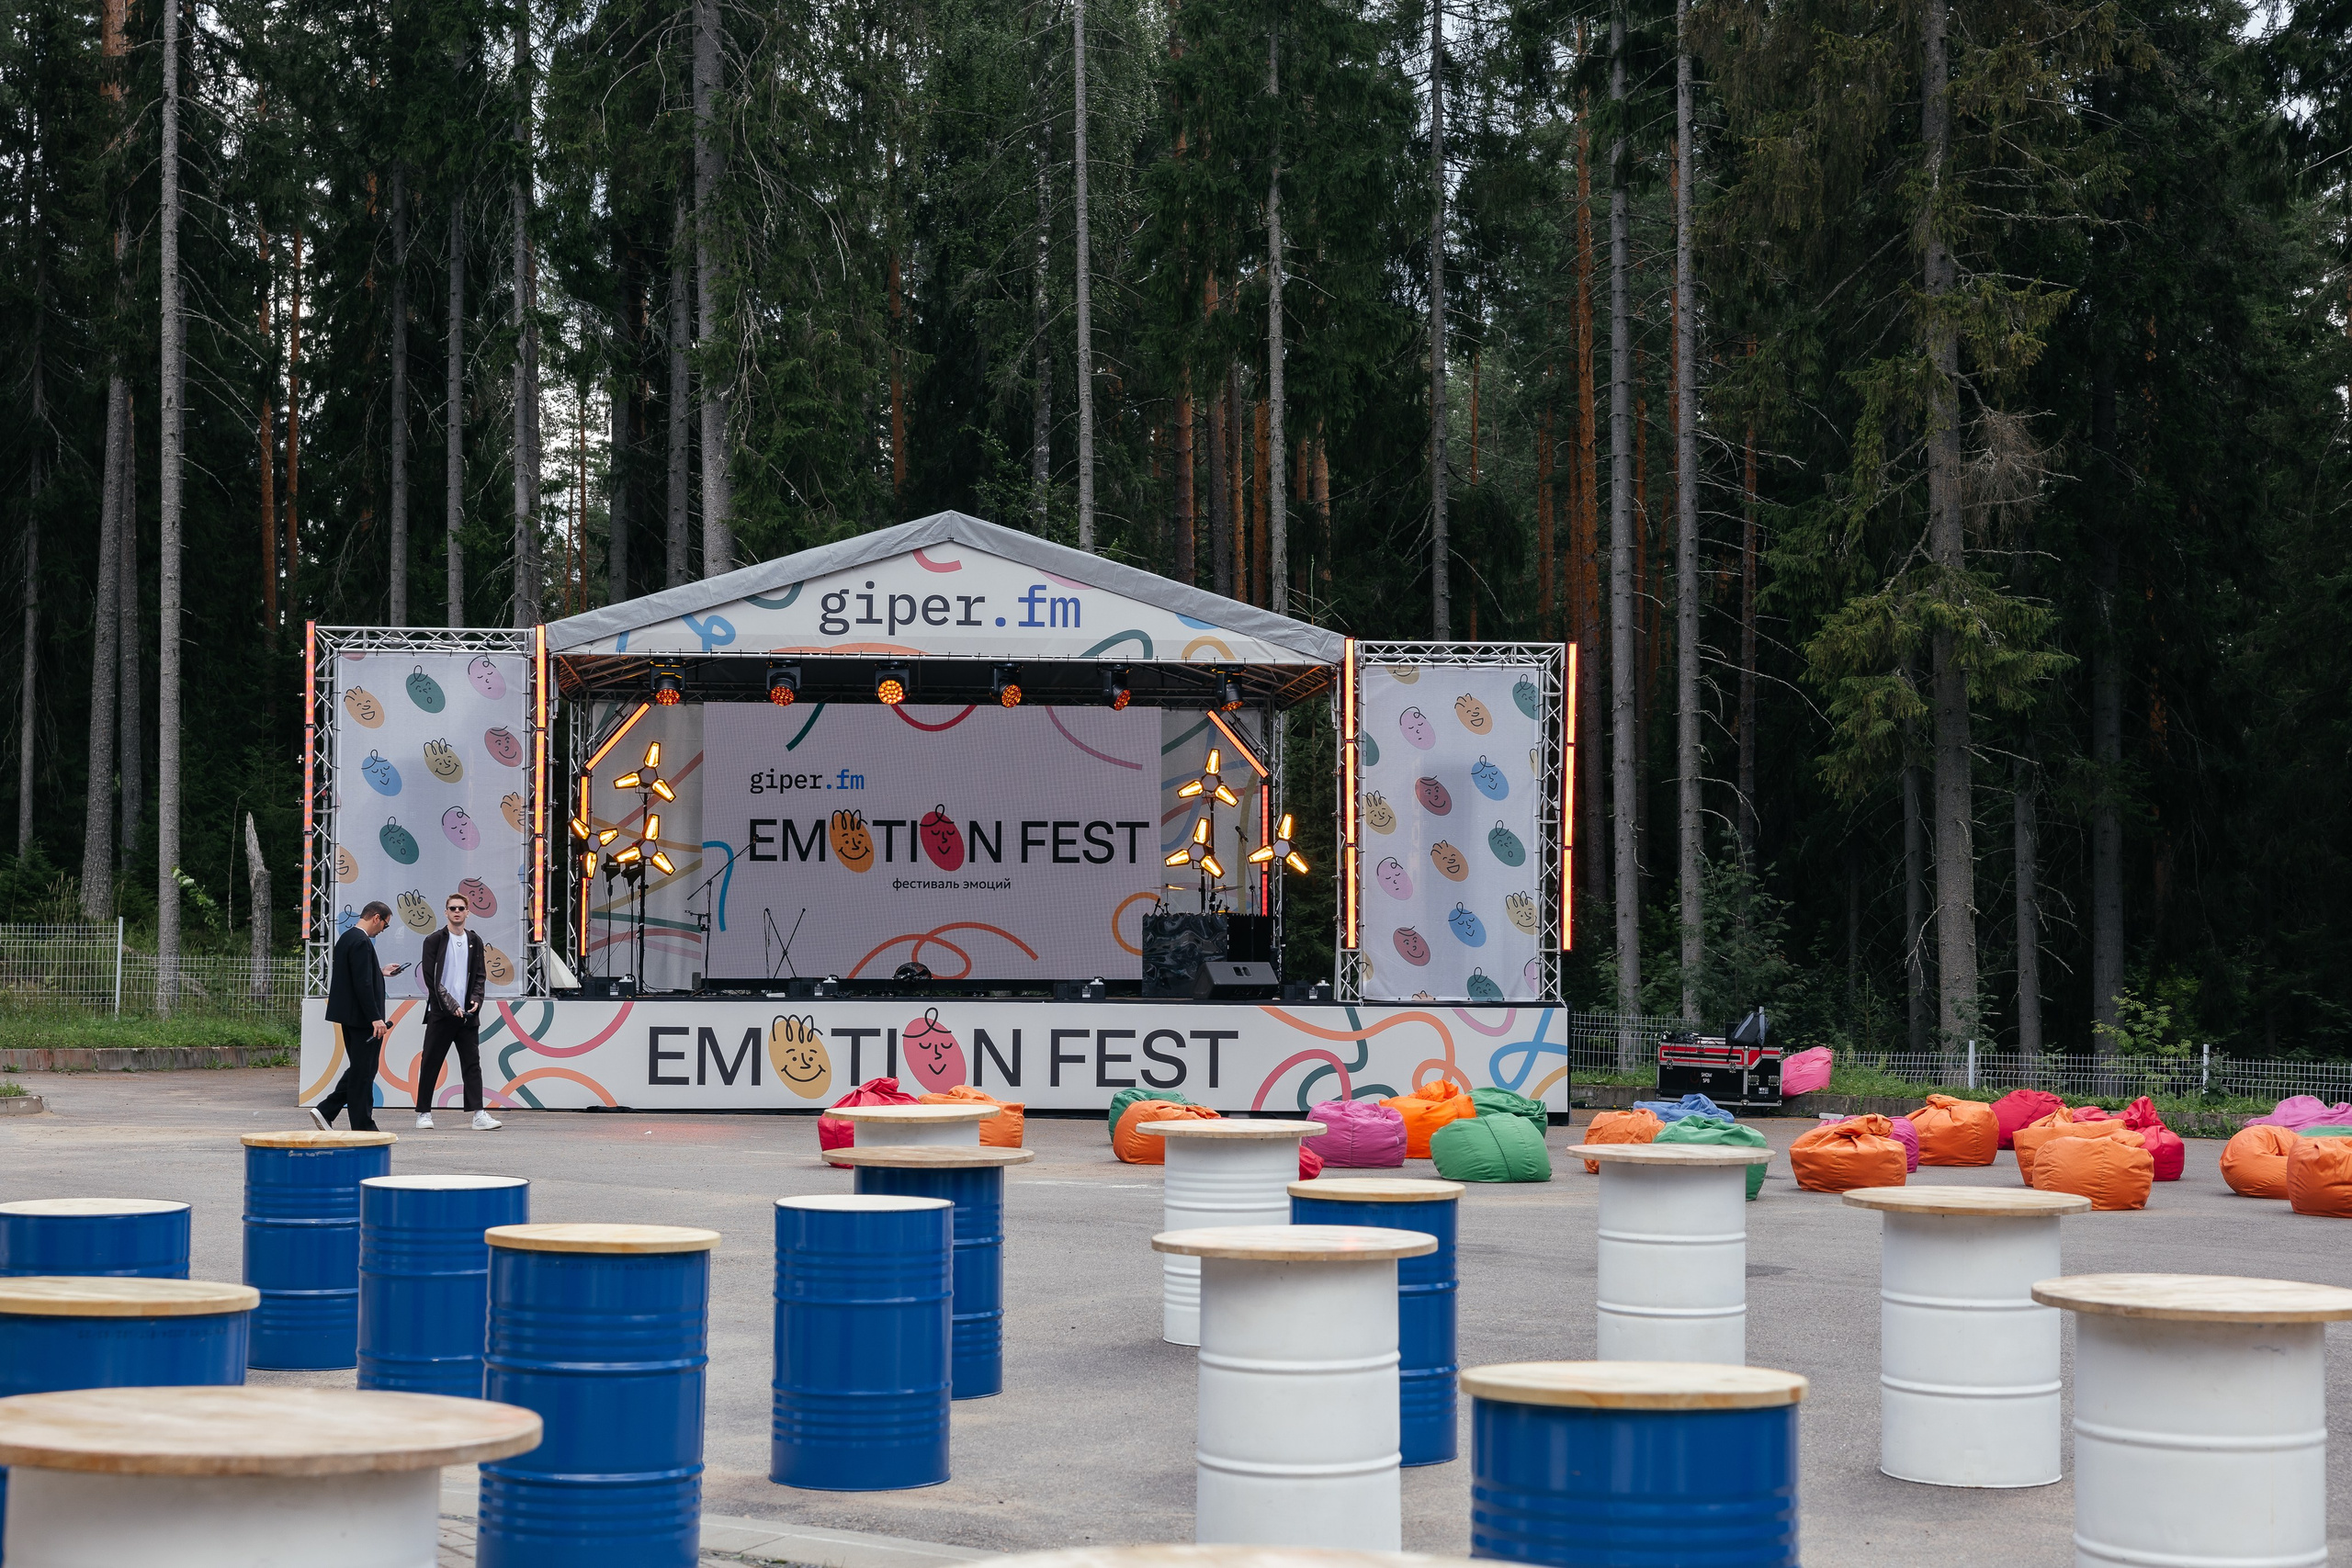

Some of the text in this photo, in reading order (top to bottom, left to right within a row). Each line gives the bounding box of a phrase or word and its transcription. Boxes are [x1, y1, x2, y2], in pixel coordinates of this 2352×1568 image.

[819, 581, 1080, 636] giper.fm
[749, 768, 865, 795] giper.fm
[1021, 820, 1150, 864] FEST
[892, 877, 1012, 891] фестиваль эмоций
[1050, 1029, 1239, 1089] FEST
